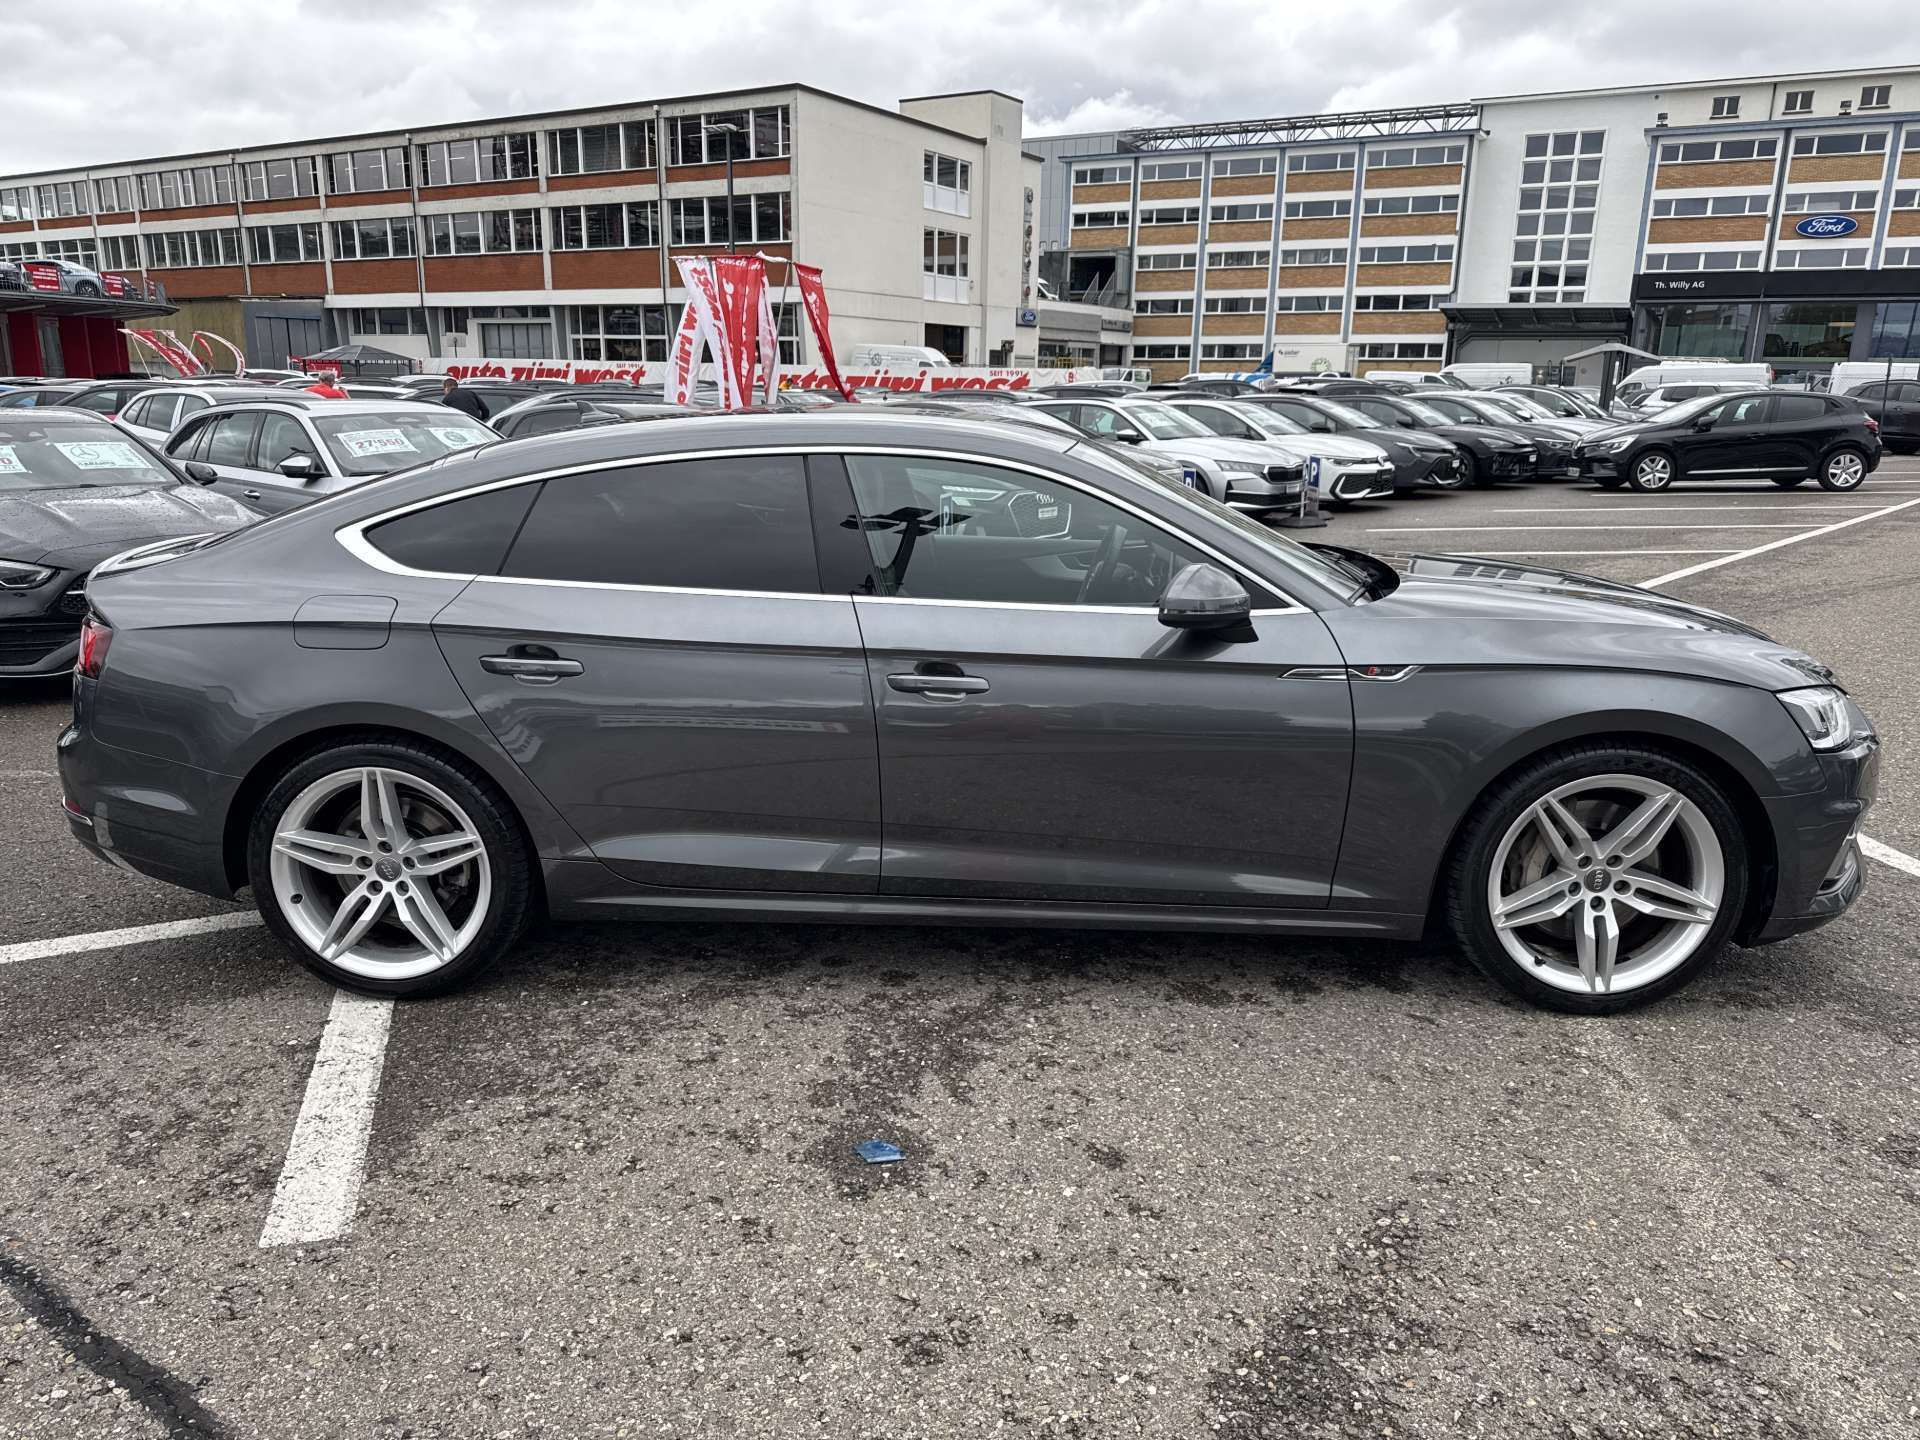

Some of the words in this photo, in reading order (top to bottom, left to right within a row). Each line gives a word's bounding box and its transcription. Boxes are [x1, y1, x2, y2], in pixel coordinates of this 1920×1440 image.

[1807, 218, 1846, 233] Ford
[1654, 281, 1667, 289] Th.
[1669, 281, 1691, 290] Willy
[1691, 280, 1705, 289] AG
[447, 361, 506, 379] auto
[1006, 369, 1023, 377] 1991
